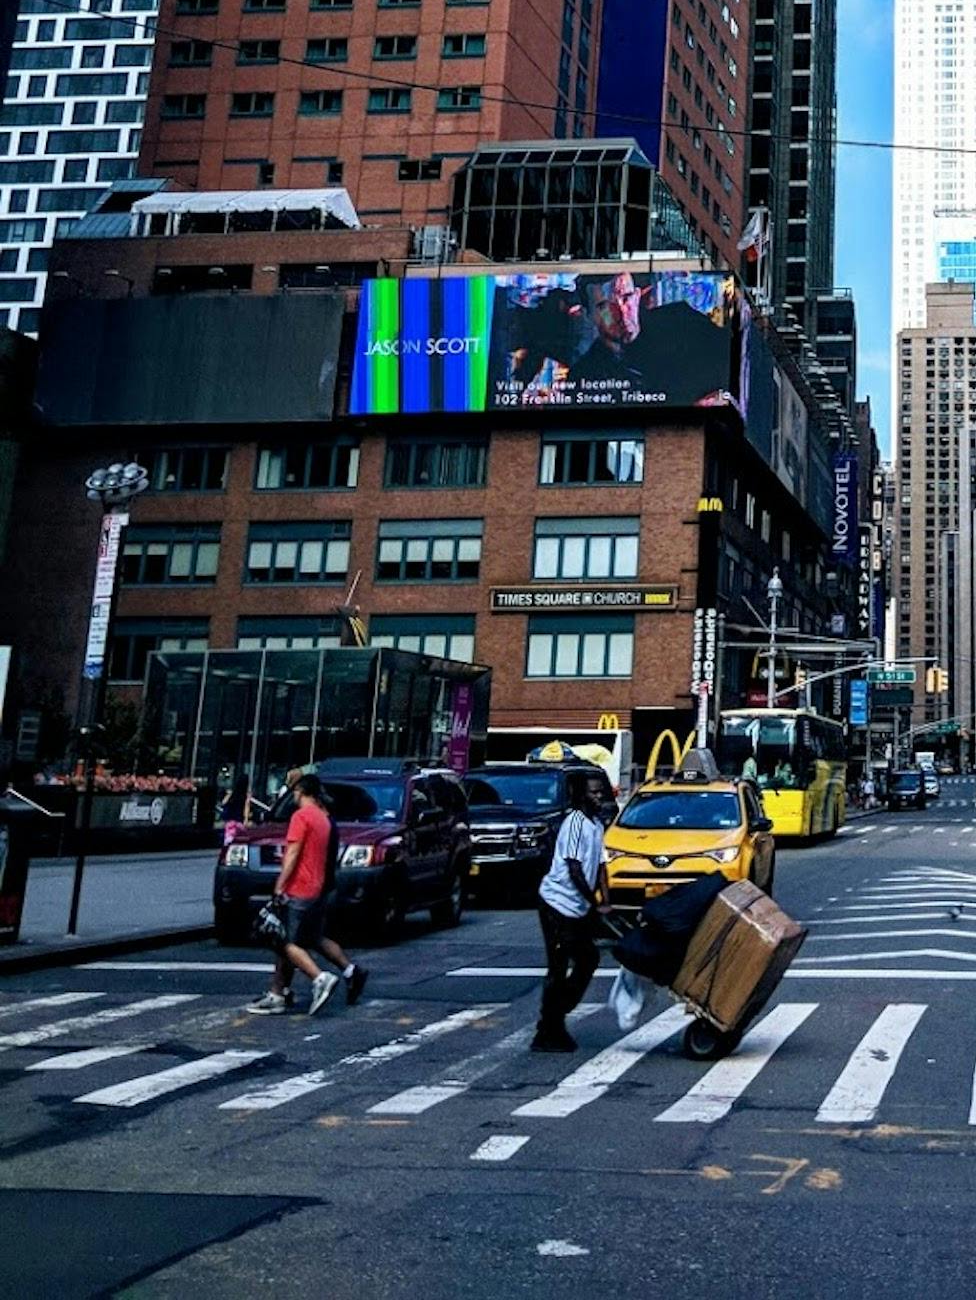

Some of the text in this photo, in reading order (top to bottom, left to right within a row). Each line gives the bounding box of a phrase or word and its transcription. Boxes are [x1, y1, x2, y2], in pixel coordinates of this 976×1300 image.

[363, 337, 479, 355] JASON SCOTT
[496, 380, 523, 390] Visit
[552, 381, 576, 390] new
[581, 378, 630, 389] location
[495, 395, 517, 405] 102
[522, 394, 571, 405] Franklin
[622, 390, 666, 402] Tribeca
[832, 461, 850, 553] NOVOTEL
[858, 535, 869, 631] BROADWAY
[497, 593, 532, 605] TIMES
[534, 592, 581, 605] SQUARE
[594, 592, 641, 605] CHURCH
[691, 608, 703, 695] McDonald's
